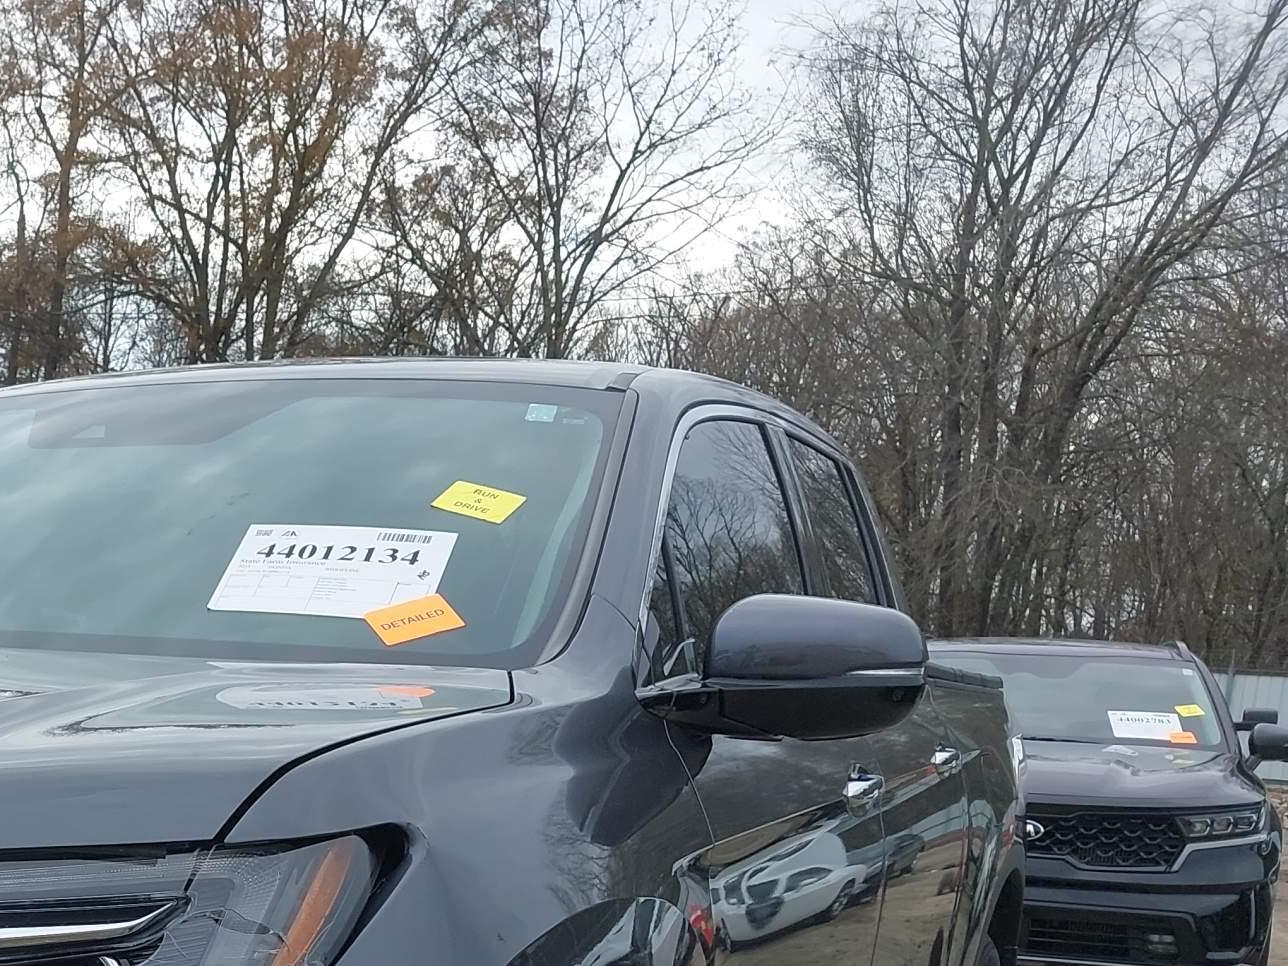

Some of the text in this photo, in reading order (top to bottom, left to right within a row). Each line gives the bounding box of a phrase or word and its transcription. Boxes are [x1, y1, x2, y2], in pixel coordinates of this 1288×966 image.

[473, 488, 500, 500] RUN
[454, 500, 491, 514] DRIVE
[256, 543, 421, 566] 44012134
[380, 608, 446, 632] DETAILED
